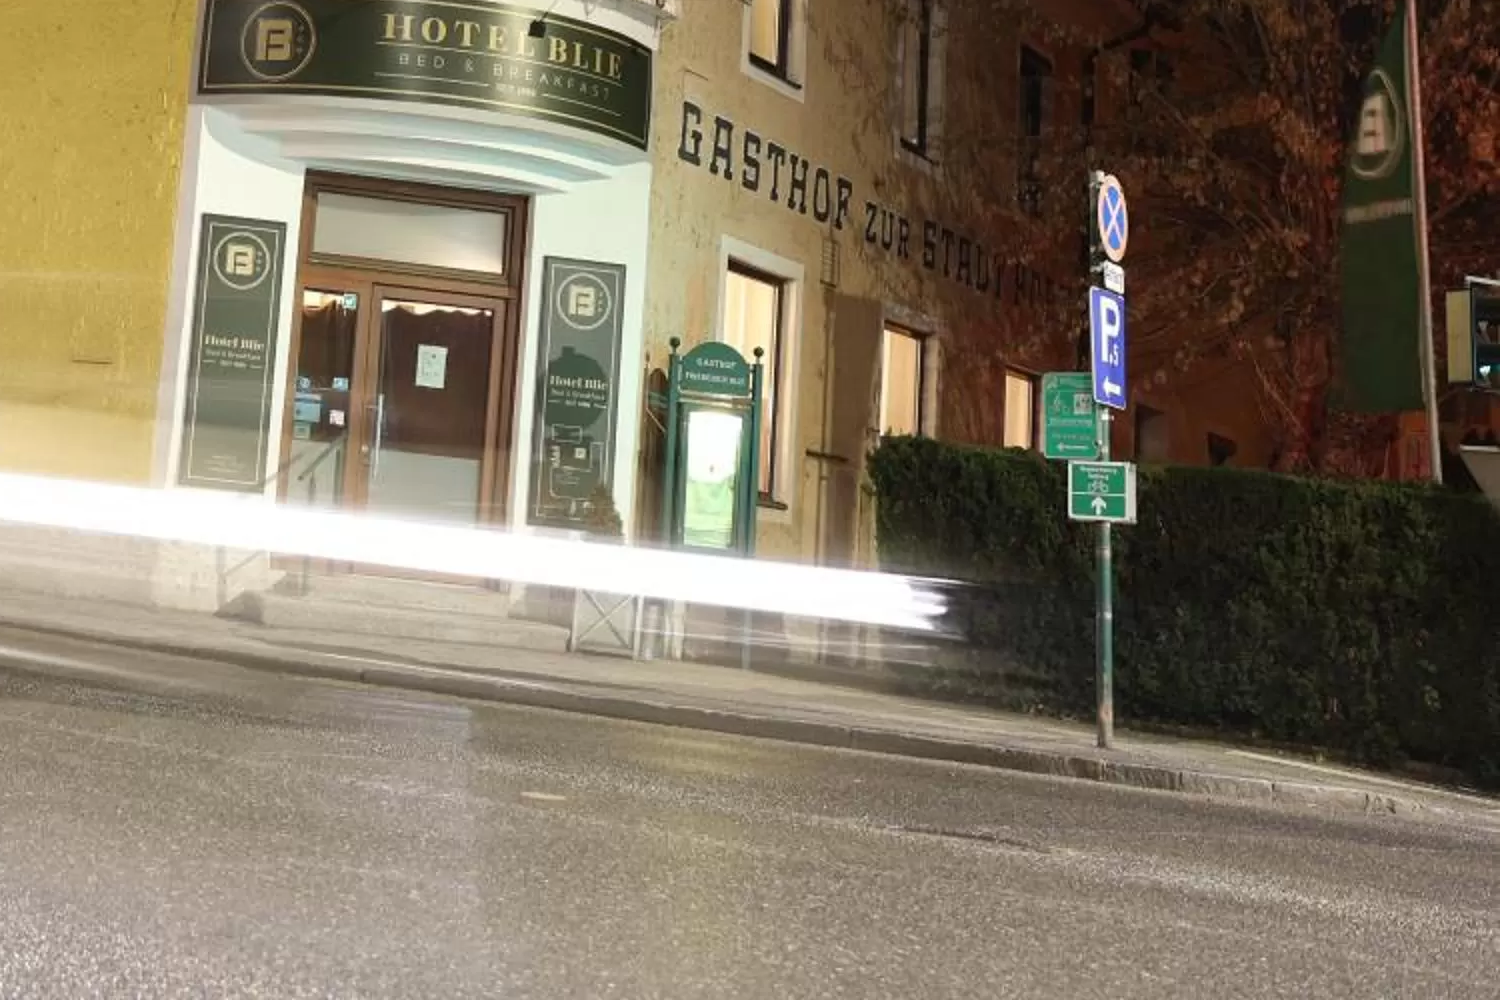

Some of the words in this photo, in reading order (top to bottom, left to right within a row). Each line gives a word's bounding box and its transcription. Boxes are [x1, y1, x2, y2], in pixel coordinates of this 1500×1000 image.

[382, 13, 536, 57] HOTEL
[547, 35, 622, 80] BLIE
[398, 54, 446, 69] BED
[464, 57, 475, 73] &
[493, 62, 610, 100] BREAKFAST
[678, 100, 853, 230] GASTHOF
[865, 201, 909, 259] ZUR
[1100, 296, 1120, 363] P
